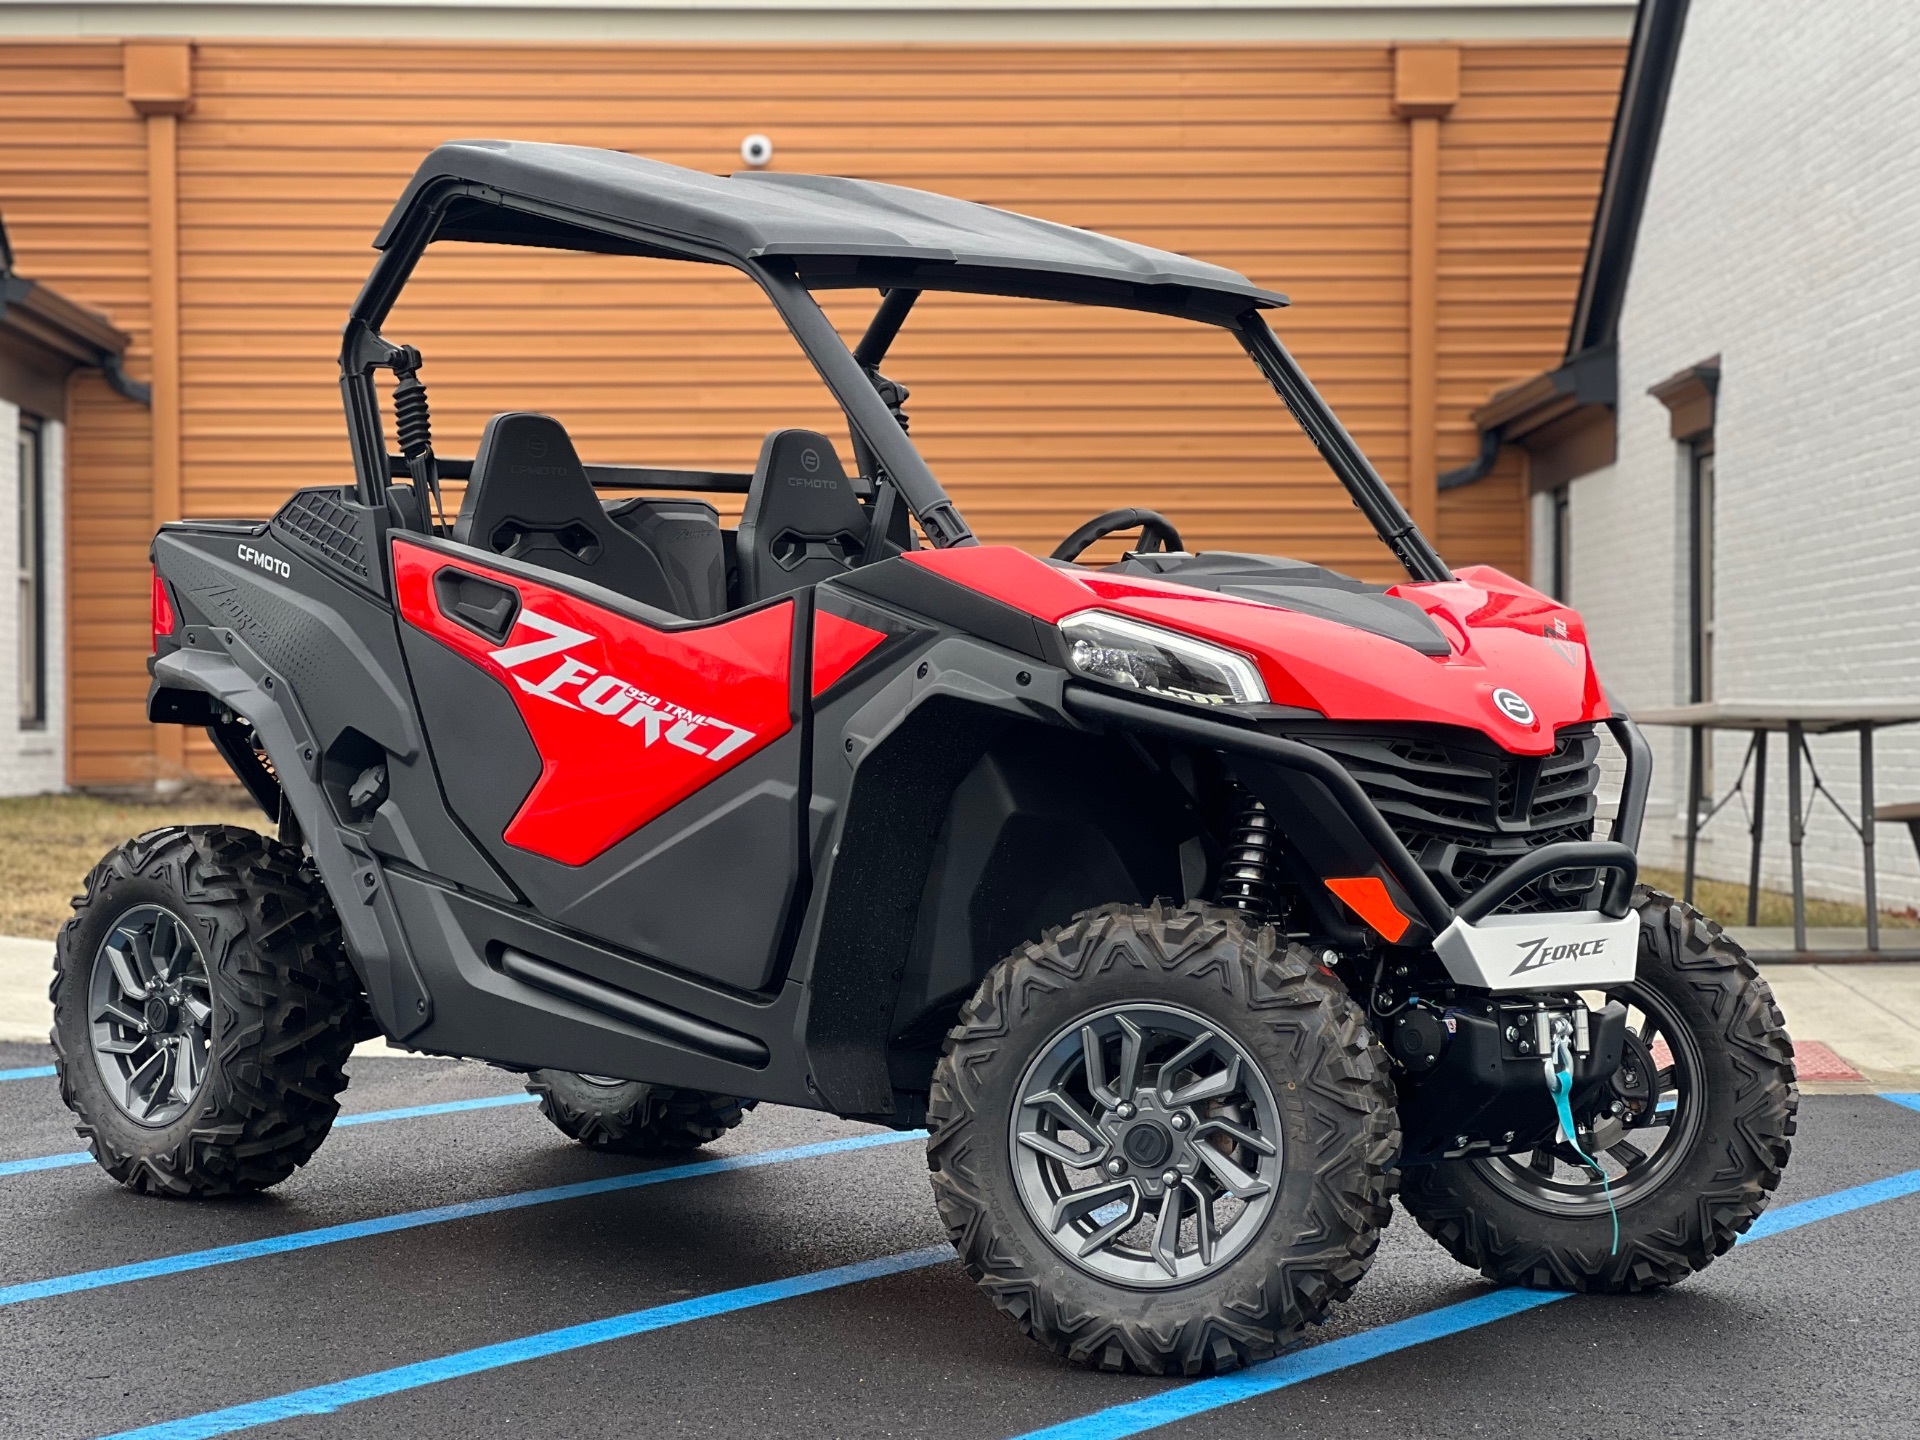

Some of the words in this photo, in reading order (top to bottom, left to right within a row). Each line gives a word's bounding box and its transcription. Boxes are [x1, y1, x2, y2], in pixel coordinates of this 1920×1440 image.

[787, 476, 838, 490] CFMOTO
[238, 543, 291, 579] CFMOTO
[625, 686, 661, 707] 950
[663, 701, 709, 727] TRAIL
[1508, 936, 1610, 978] ZFORCE
